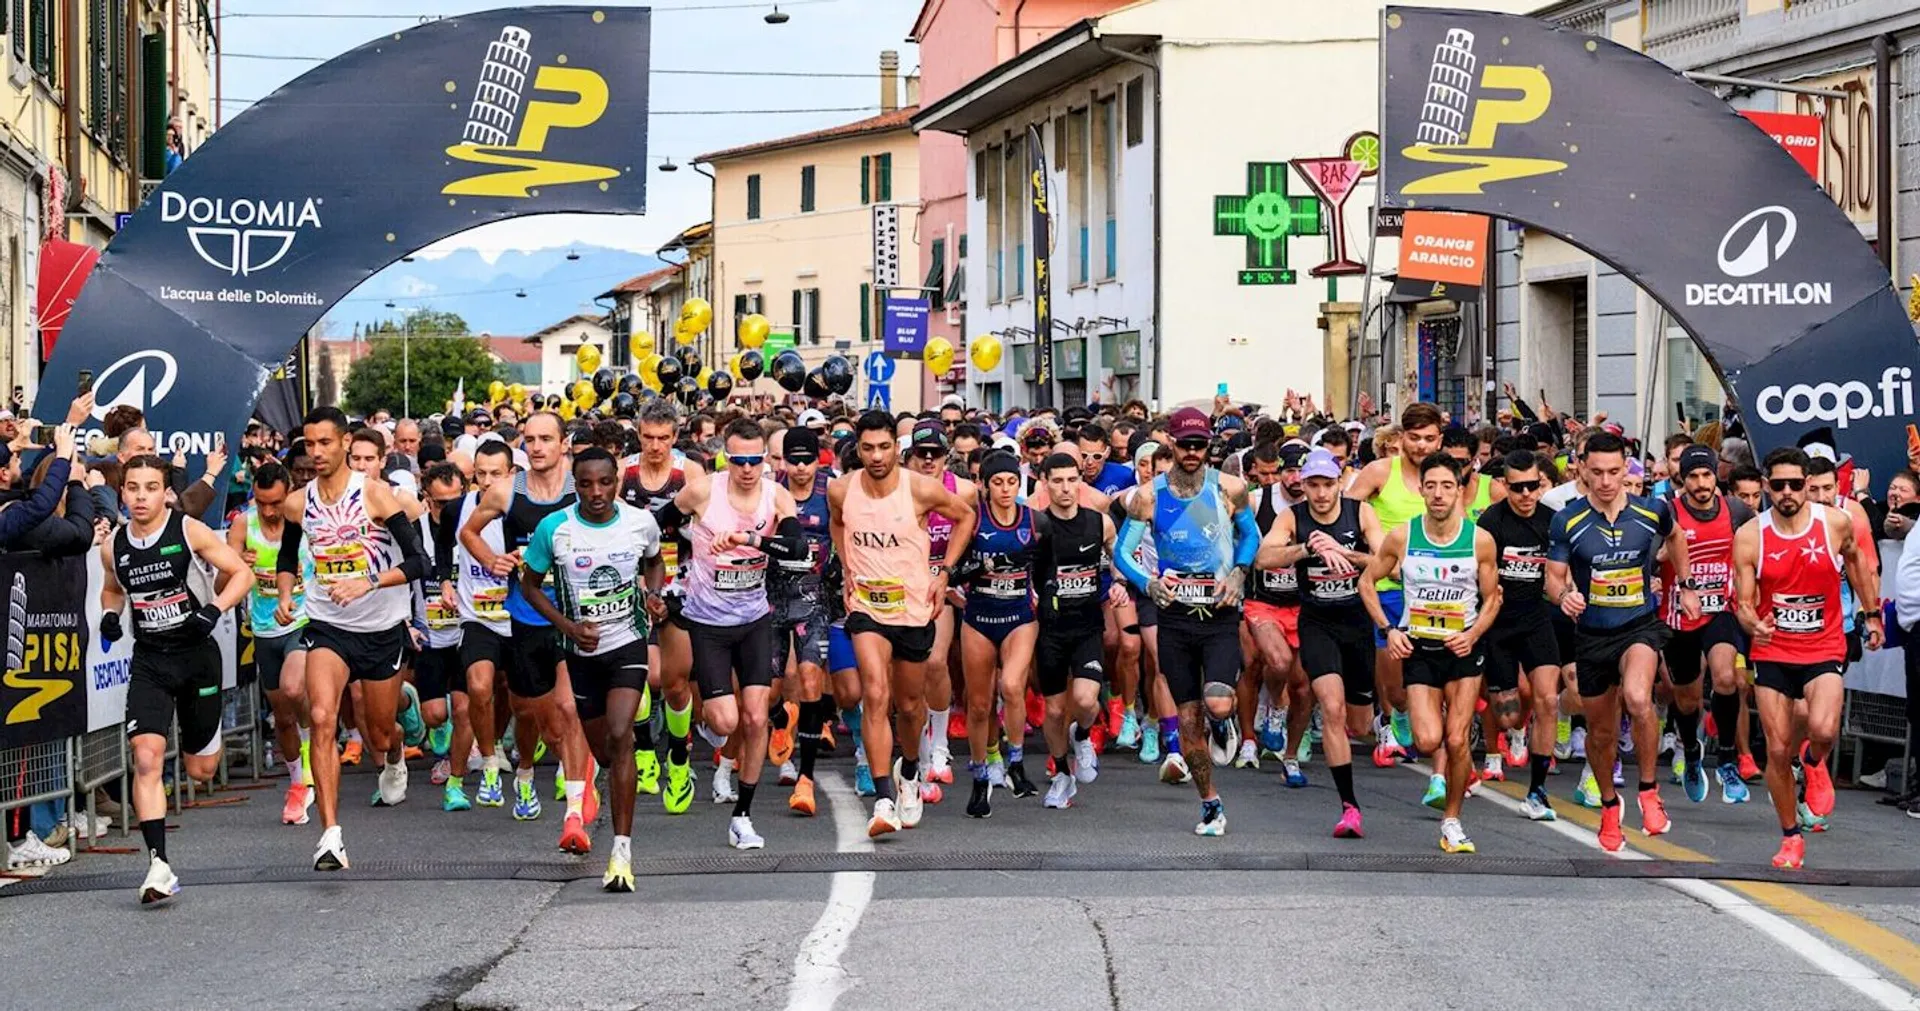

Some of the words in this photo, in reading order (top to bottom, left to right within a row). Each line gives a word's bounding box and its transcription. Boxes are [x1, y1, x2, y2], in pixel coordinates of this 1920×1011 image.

[1785, 134, 1817, 147] GRID
[1320, 161, 1351, 186] BAR
[1377, 214, 1404, 227] NEW
[877, 210, 886, 285] PIZZERIA
[1413, 234, 1476, 252] ORANGE
[1408, 250, 1476, 269] ARANCIO
[216, 288, 253, 302] delle
[255, 290, 323, 306] Dolomiti
[1685, 282, 1832, 306] DECATHLON
[896, 327, 917, 336] BLUE
[898, 336, 915, 344] BLU
[1756, 366, 1914, 429] coop.fi
[853, 531, 900, 548] SINA
[1591, 550, 1642, 564] ELITE
[128, 561, 172, 577] ATLETICA
[326, 560, 355, 574] 173
[1506, 560, 1541, 573] 3834
[129, 569, 174, 586] BIOTEKNA
[990, 579, 1016, 591] EPIS
[1315, 578, 1354, 593] 2021
[1606, 584, 1627, 597] 30
[869, 591, 889, 604] 65
[141, 602, 182, 622] TONIN
[586, 600, 631, 618] 3904
[1776, 608, 1818, 623] 2061
[1427, 615, 1446, 629] 11
[24, 631, 81, 673] PISA
